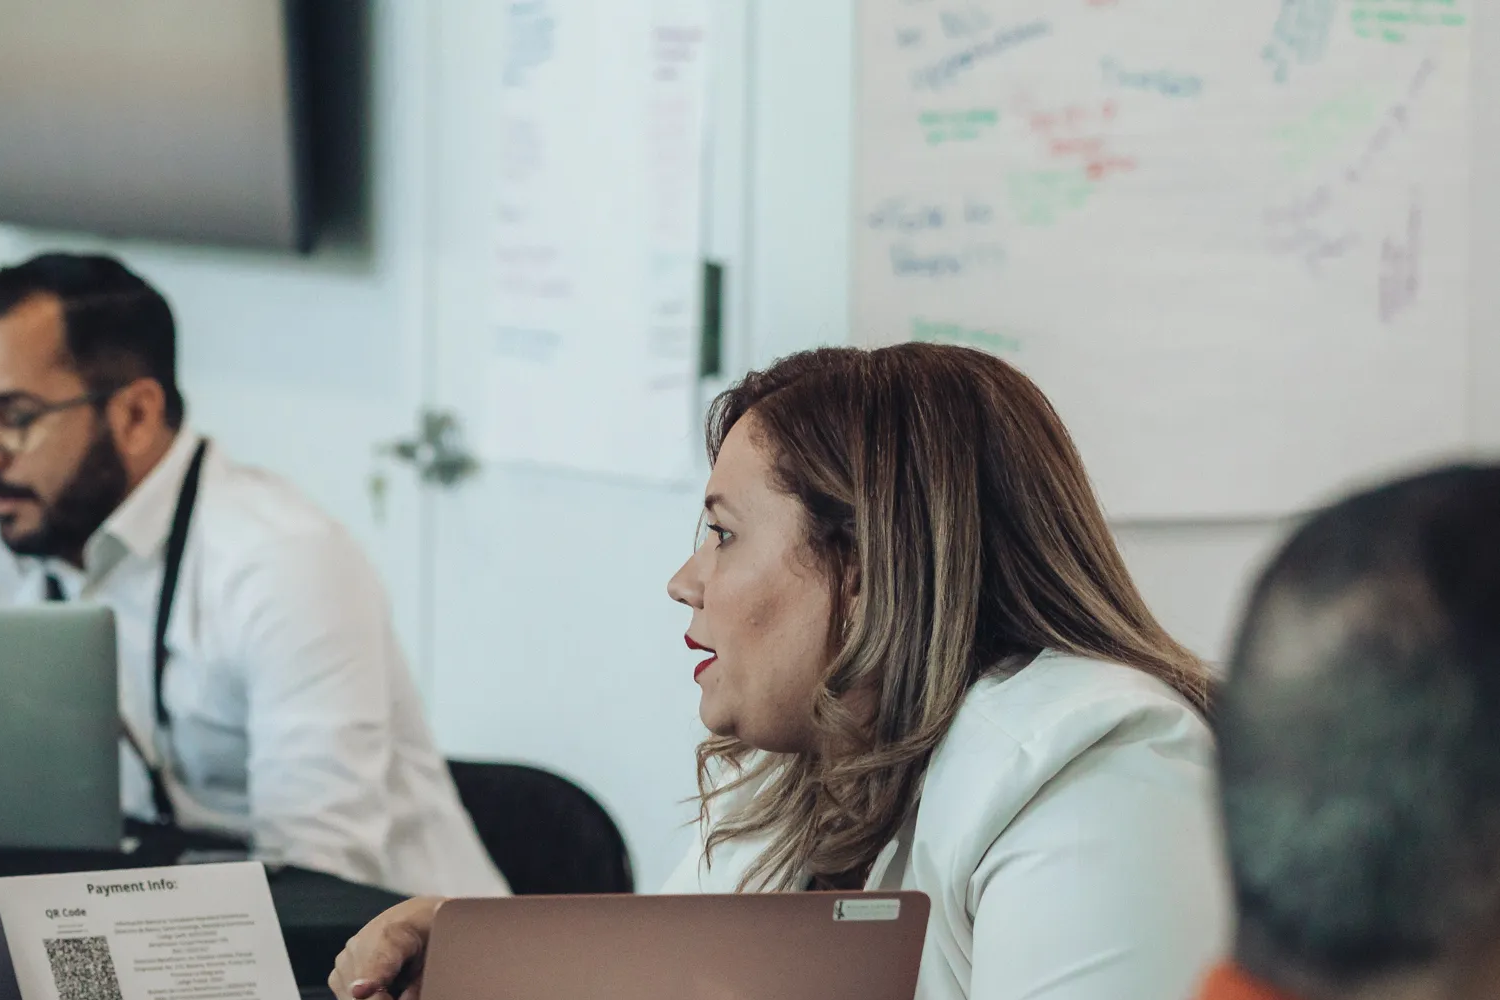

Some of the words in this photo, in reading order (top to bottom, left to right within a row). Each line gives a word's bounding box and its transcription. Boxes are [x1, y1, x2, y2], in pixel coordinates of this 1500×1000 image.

[87, 882, 146, 897] Payment
[148, 878, 179, 892] Info:
[45, 909, 61, 920] QR
[63, 908, 87, 918] Code
